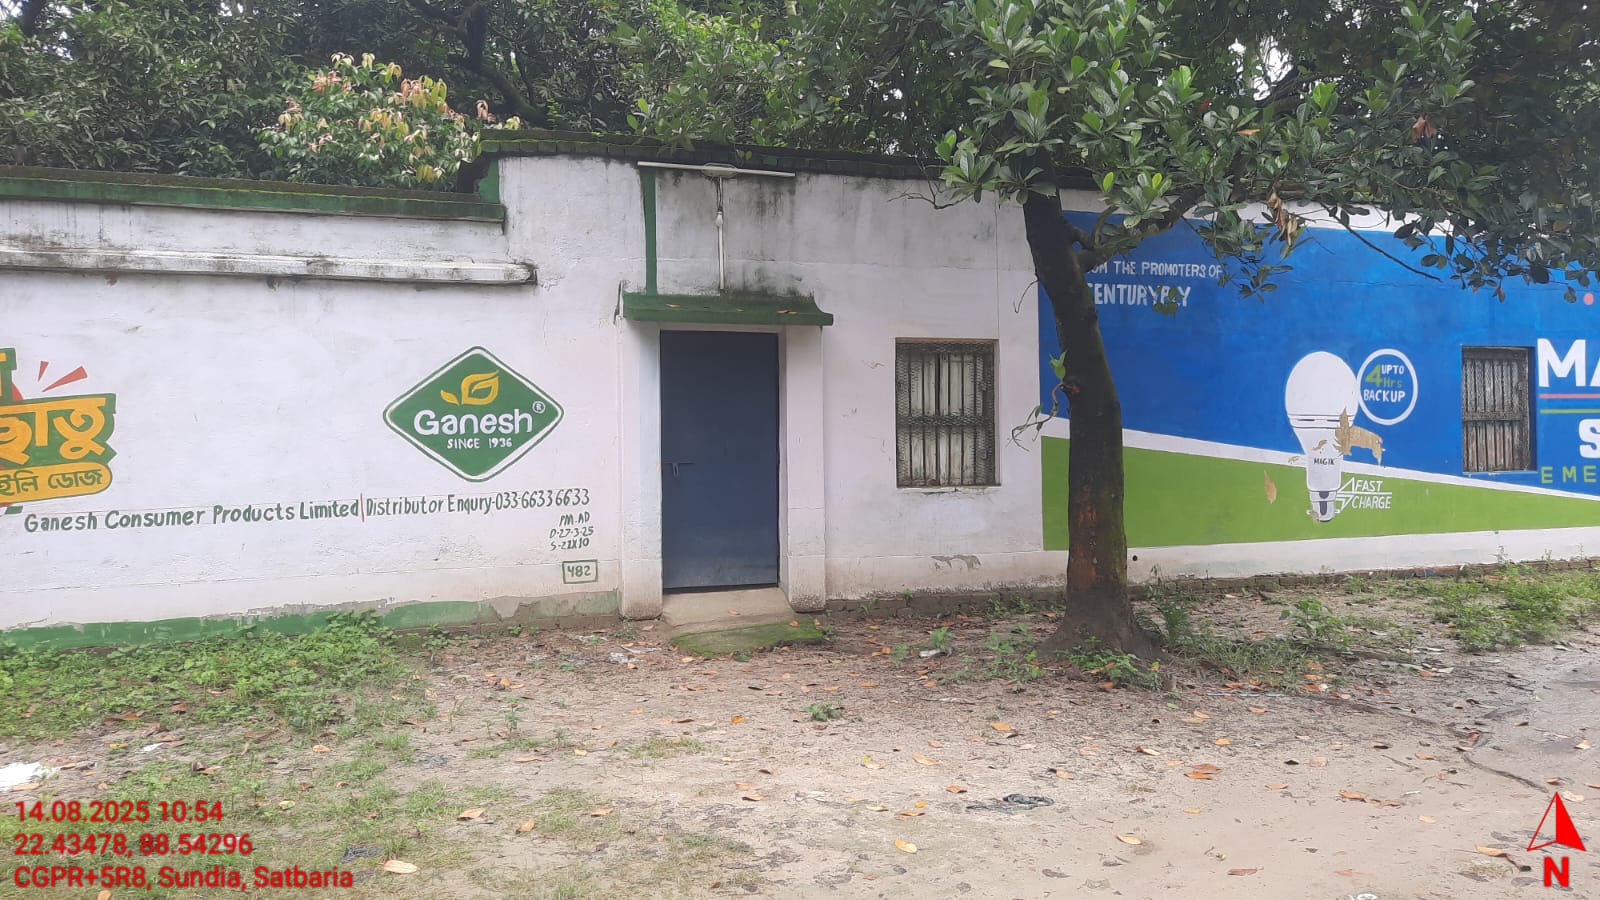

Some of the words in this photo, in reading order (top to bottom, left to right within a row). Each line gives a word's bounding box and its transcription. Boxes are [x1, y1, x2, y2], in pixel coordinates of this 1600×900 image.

[1113, 260, 1136, 275] THE
[1141, 262, 1207, 278] PROMOTERS
[1208, 264, 1223, 279] OF
[1087, 282, 1192, 307] ENTURYPY
[1365, 363, 1382, 388] 4
[1383, 377, 1403, 389] Hrs
[1363, 389, 1406, 403] BACKUP
[413, 408, 533, 436] Ganesh
[447, 438, 480, 450] SINCE
[488, 437, 512, 449] 1936
[48, 468, 103, 490] ডোজ
[1355, 479, 1383, 493] FAST
[1352, 496, 1392, 510] CHARGE
[24, 513, 98, 533] Ganesh
[104, 508, 205, 530] Consumer
[212, 502, 295, 525] Products
[299, 499, 359, 520] Limited
[366, 496, 444, 516] Distributor
[567, 565, 591, 577] 482
